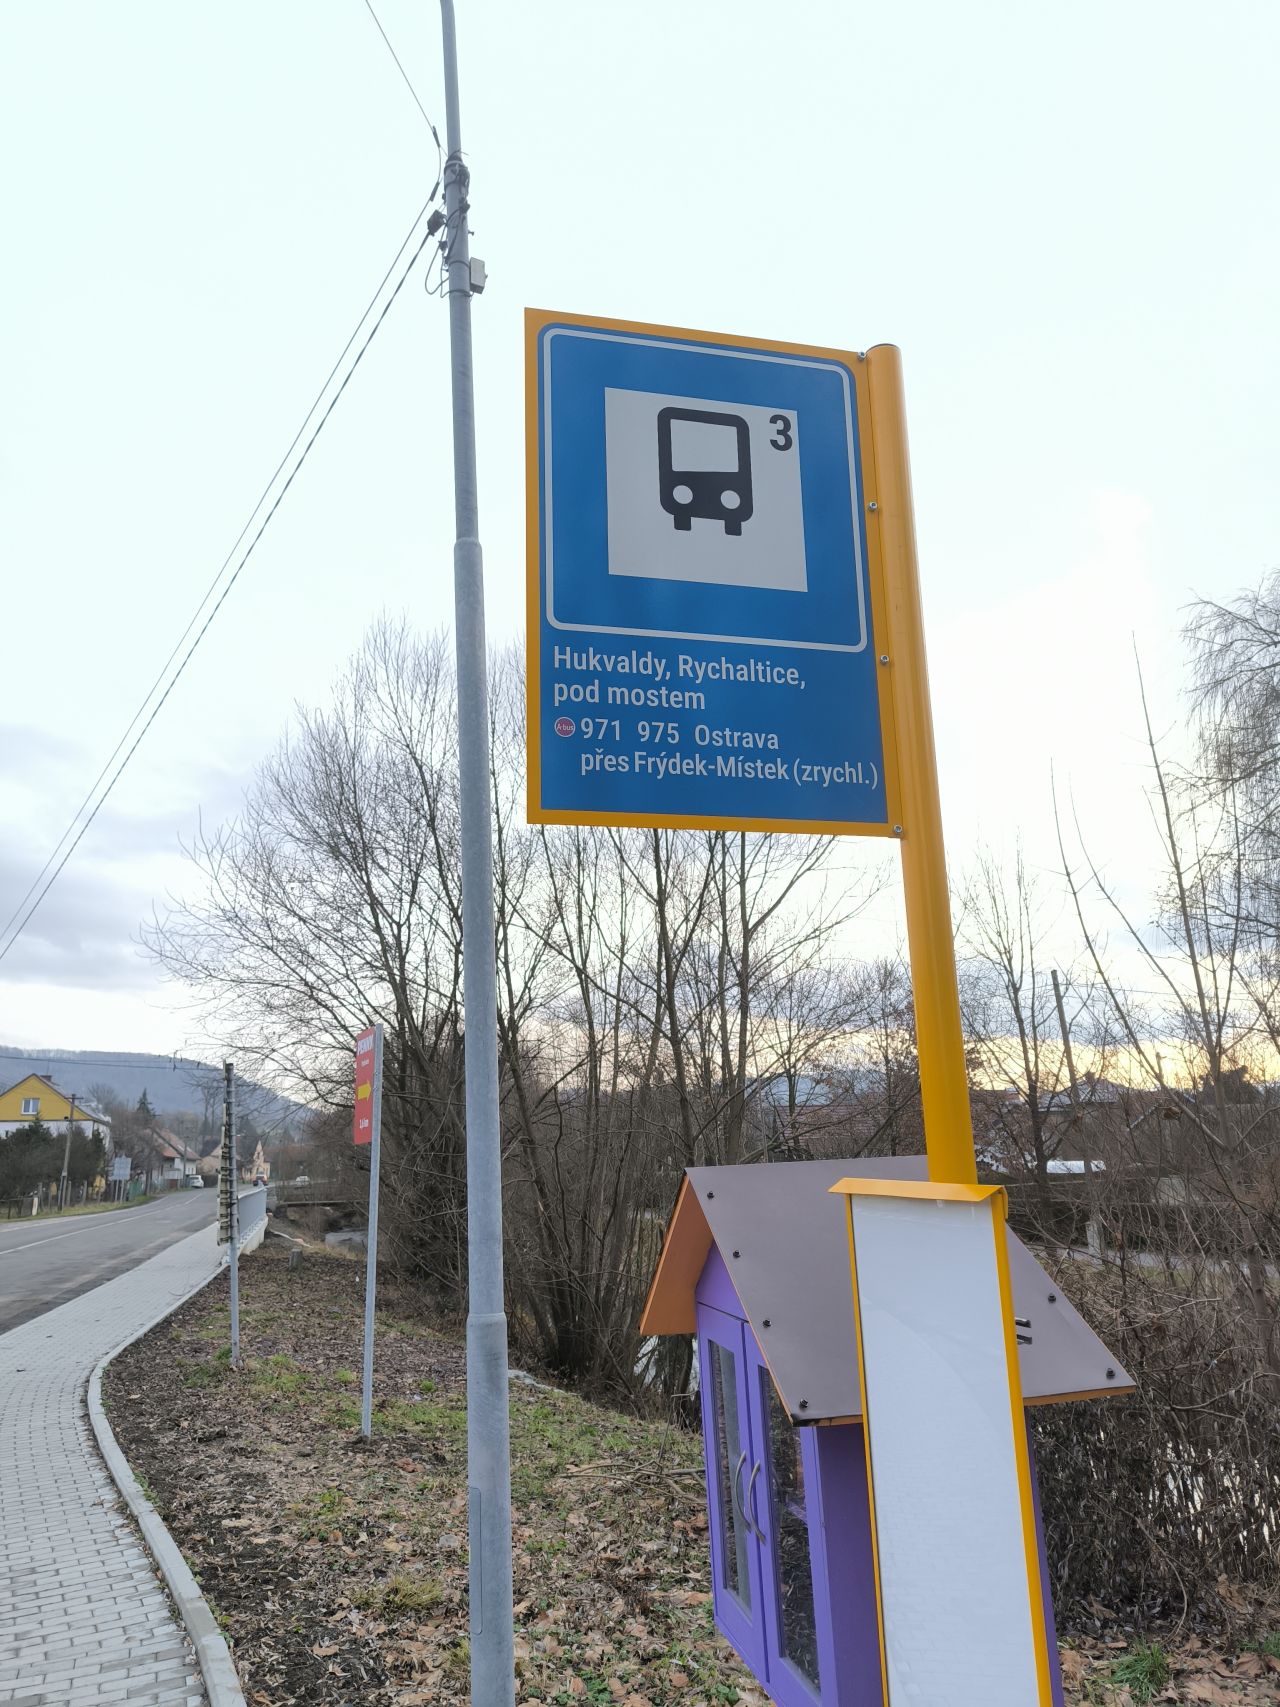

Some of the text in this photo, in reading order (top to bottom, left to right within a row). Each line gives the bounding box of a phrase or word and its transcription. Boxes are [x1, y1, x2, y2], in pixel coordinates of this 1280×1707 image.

[769, 414, 793, 451] 3
[554, 645, 805, 689] Hukvaldy, Rychaltice,
[554, 679, 705, 709] pod mostem
[580, 717, 619, 740] 971
[637, 720, 679, 743] 975
[694, 724, 778, 749] Ostrava
[581, 748, 877, 789] přes Frýdek-Místek (zrychl.)
